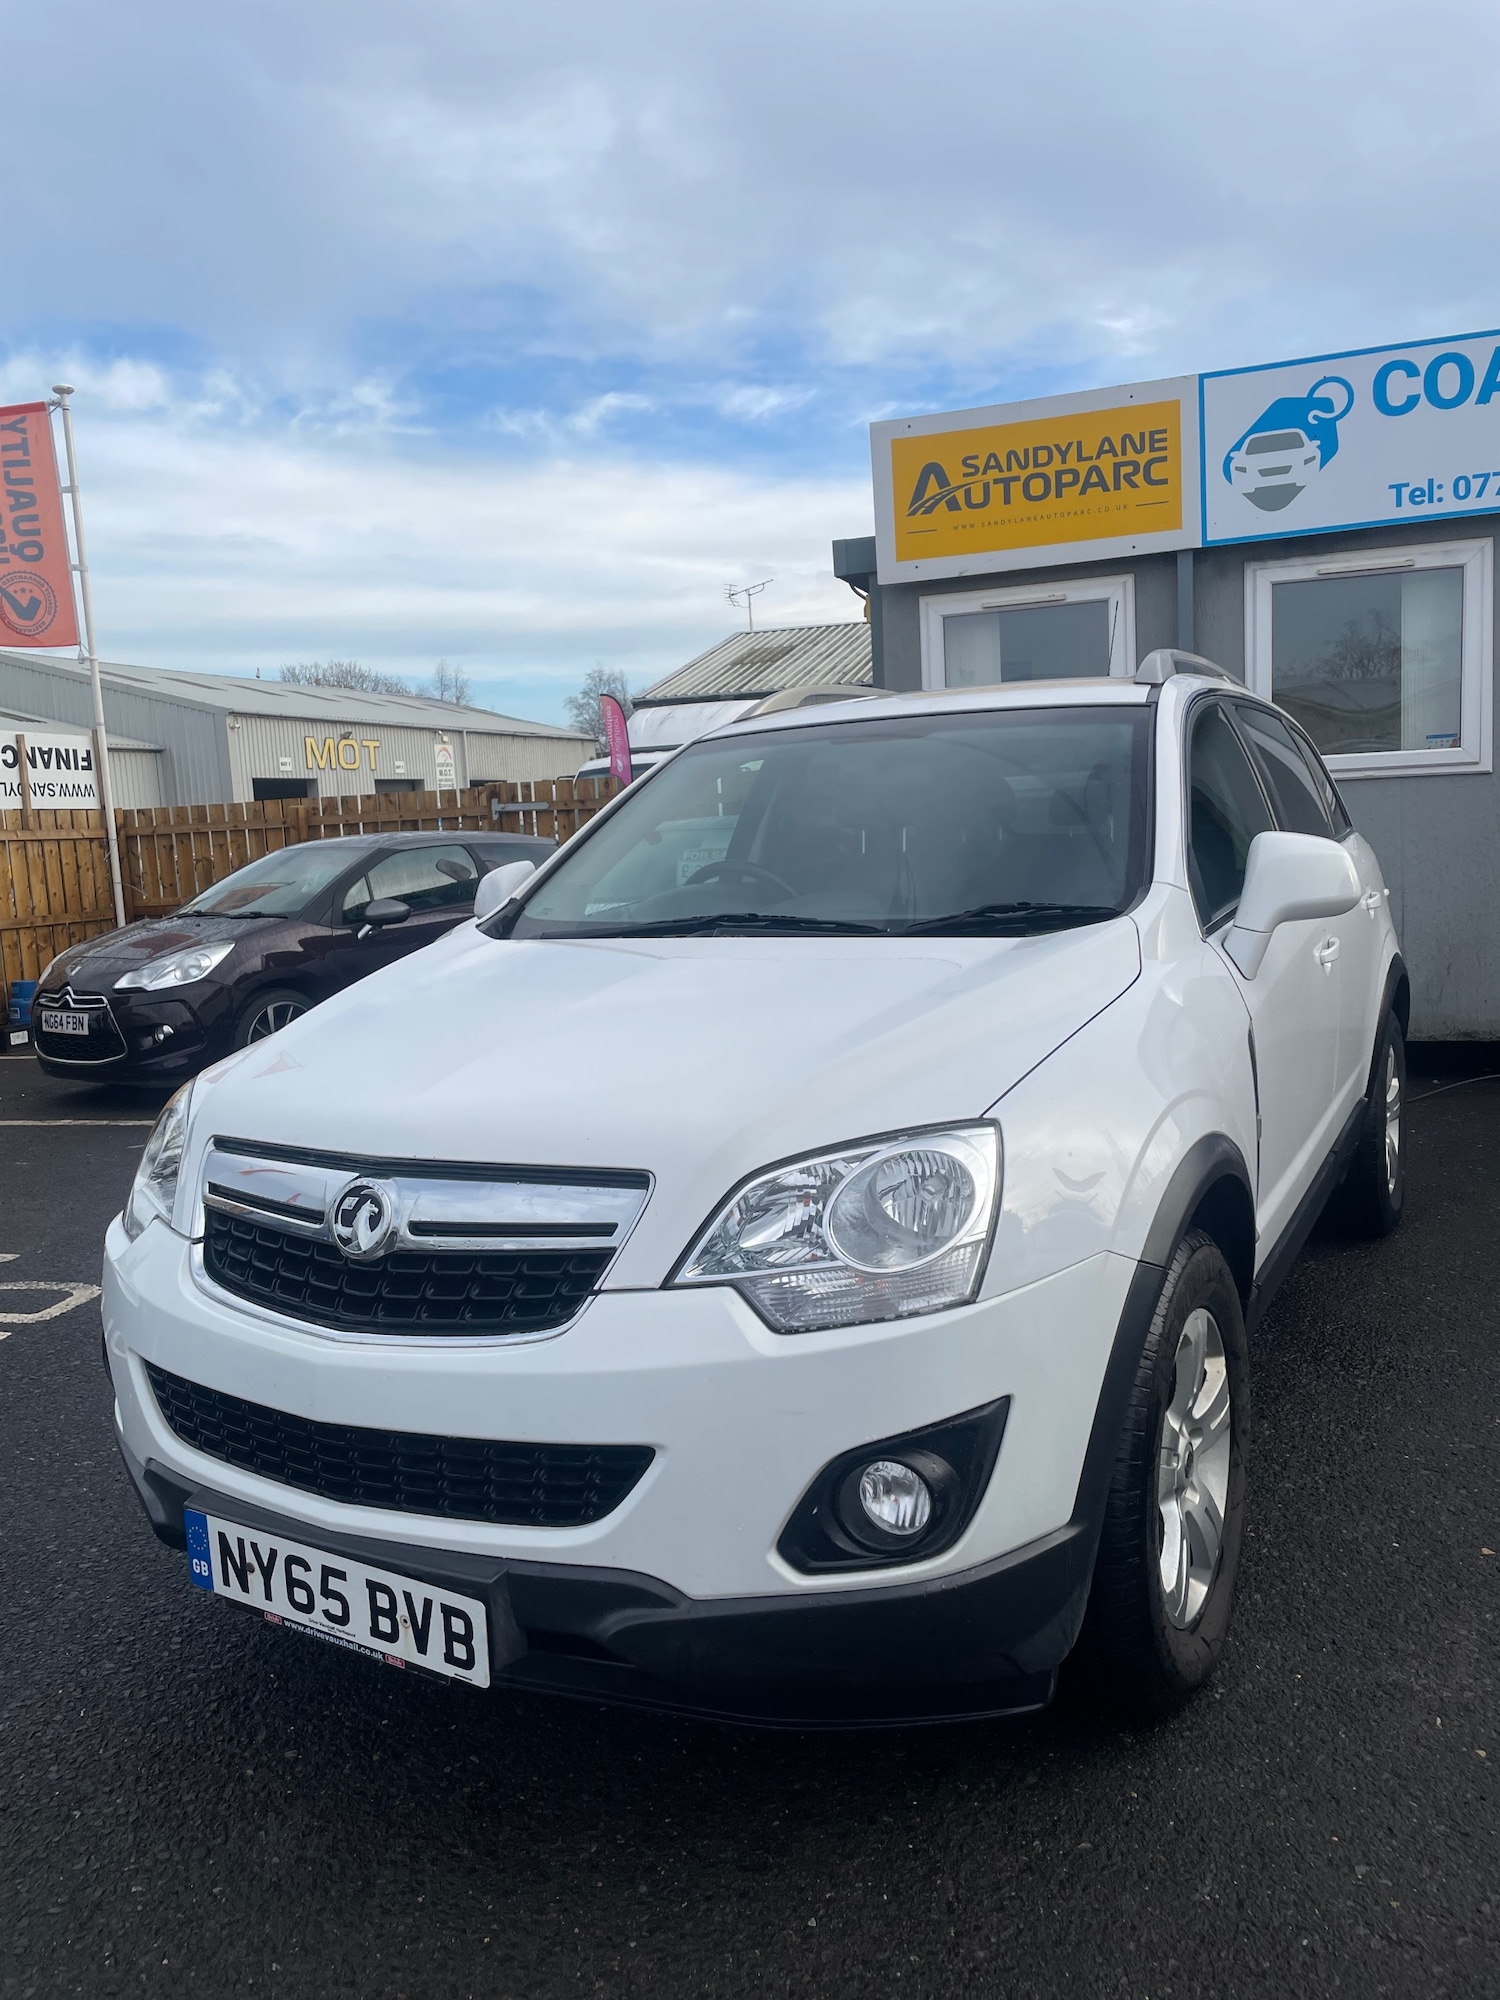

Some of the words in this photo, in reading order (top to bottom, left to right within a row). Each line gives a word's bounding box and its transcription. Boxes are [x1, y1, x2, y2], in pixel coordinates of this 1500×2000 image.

[961, 428, 1168, 478] SANDYLANE
[906, 456, 1168, 516] AUTOPARC
[1388, 478, 1444, 508] Tel:
[953, 503, 1129, 531] WWW.SANDYLANEAUTOPARC.CO.UK
[303, 735, 381, 772] MOT
[683, 851, 708, 860] FOR
[66, 1015, 84, 1031] FBN
[192, 1558, 209, 1577] GB
[217, 1530, 350, 1627] NY65
[365, 1577, 475, 1671] BVB
[284, 1619, 384, 1661] www.drivevauxhall.co.uk
